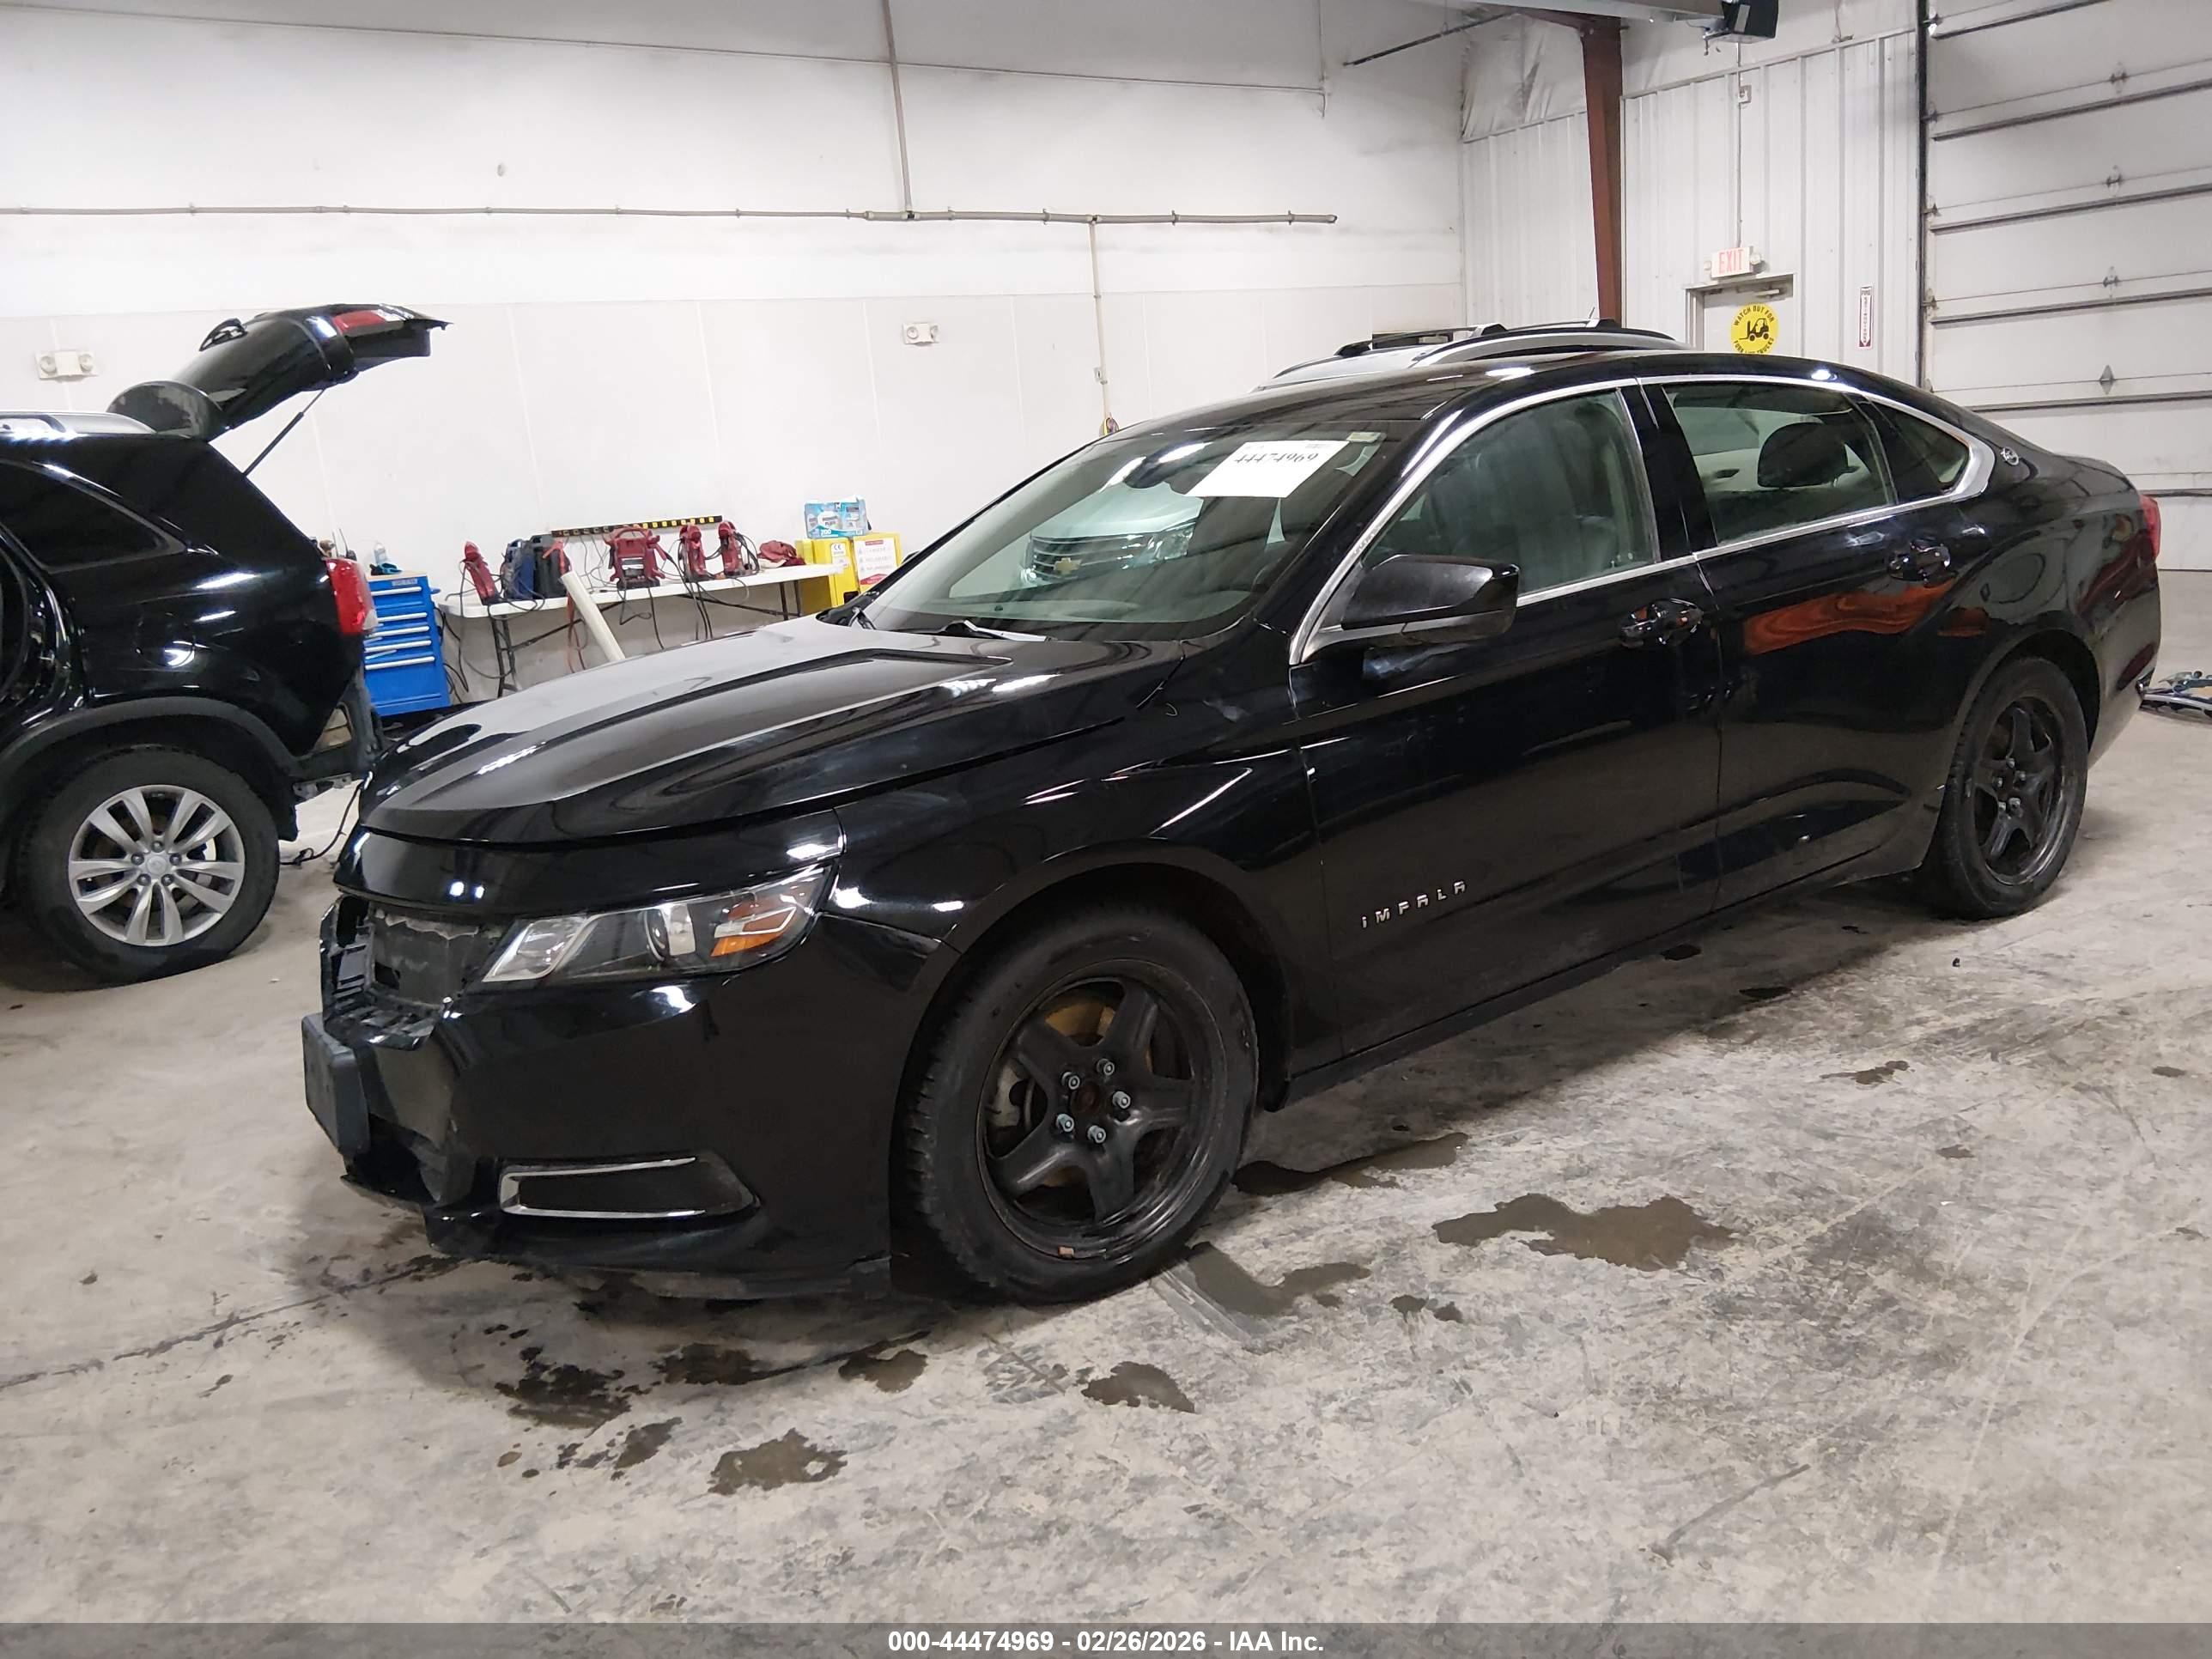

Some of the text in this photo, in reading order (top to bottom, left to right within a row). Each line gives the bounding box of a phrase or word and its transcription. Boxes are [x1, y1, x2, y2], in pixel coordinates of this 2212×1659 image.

[1719, 249, 1744, 274] EXIT
[1734, 305, 1775, 326] WATCH OUT FOR
[1361, 881, 1466, 928] IMPALA
